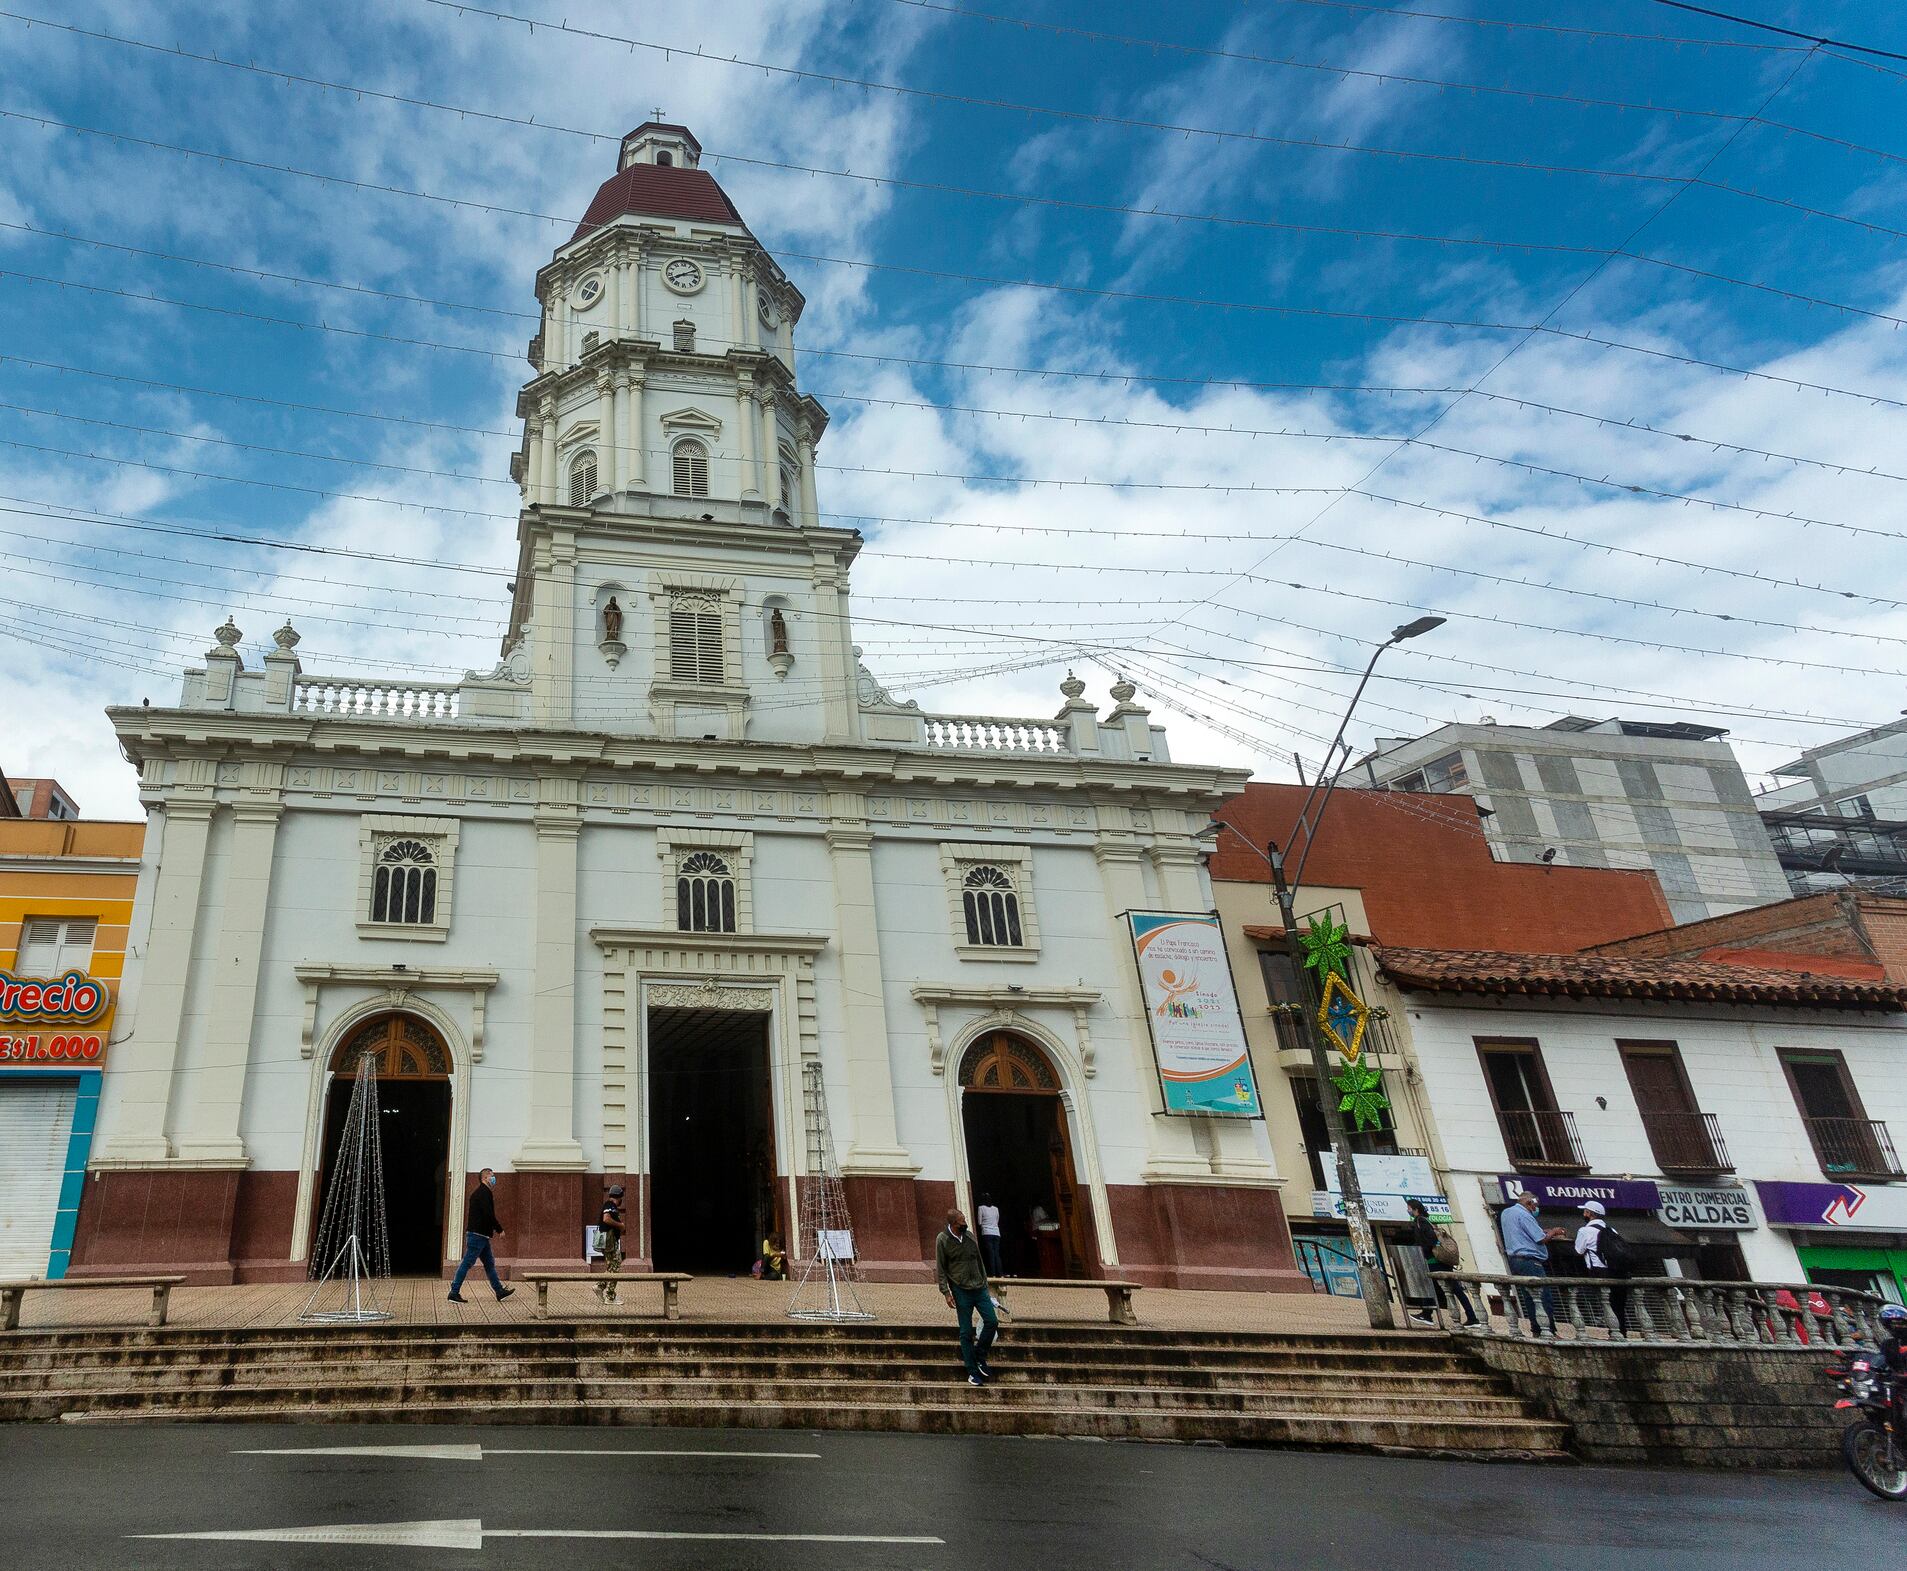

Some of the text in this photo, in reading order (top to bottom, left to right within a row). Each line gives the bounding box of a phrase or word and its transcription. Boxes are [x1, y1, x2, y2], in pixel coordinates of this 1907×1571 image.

[1546, 1186, 1615, 1199] RADIANTY
[1659, 1191, 1751, 1205] ENTRO COMERCIAL
[1665, 1205, 1750, 1224] CALDAS
